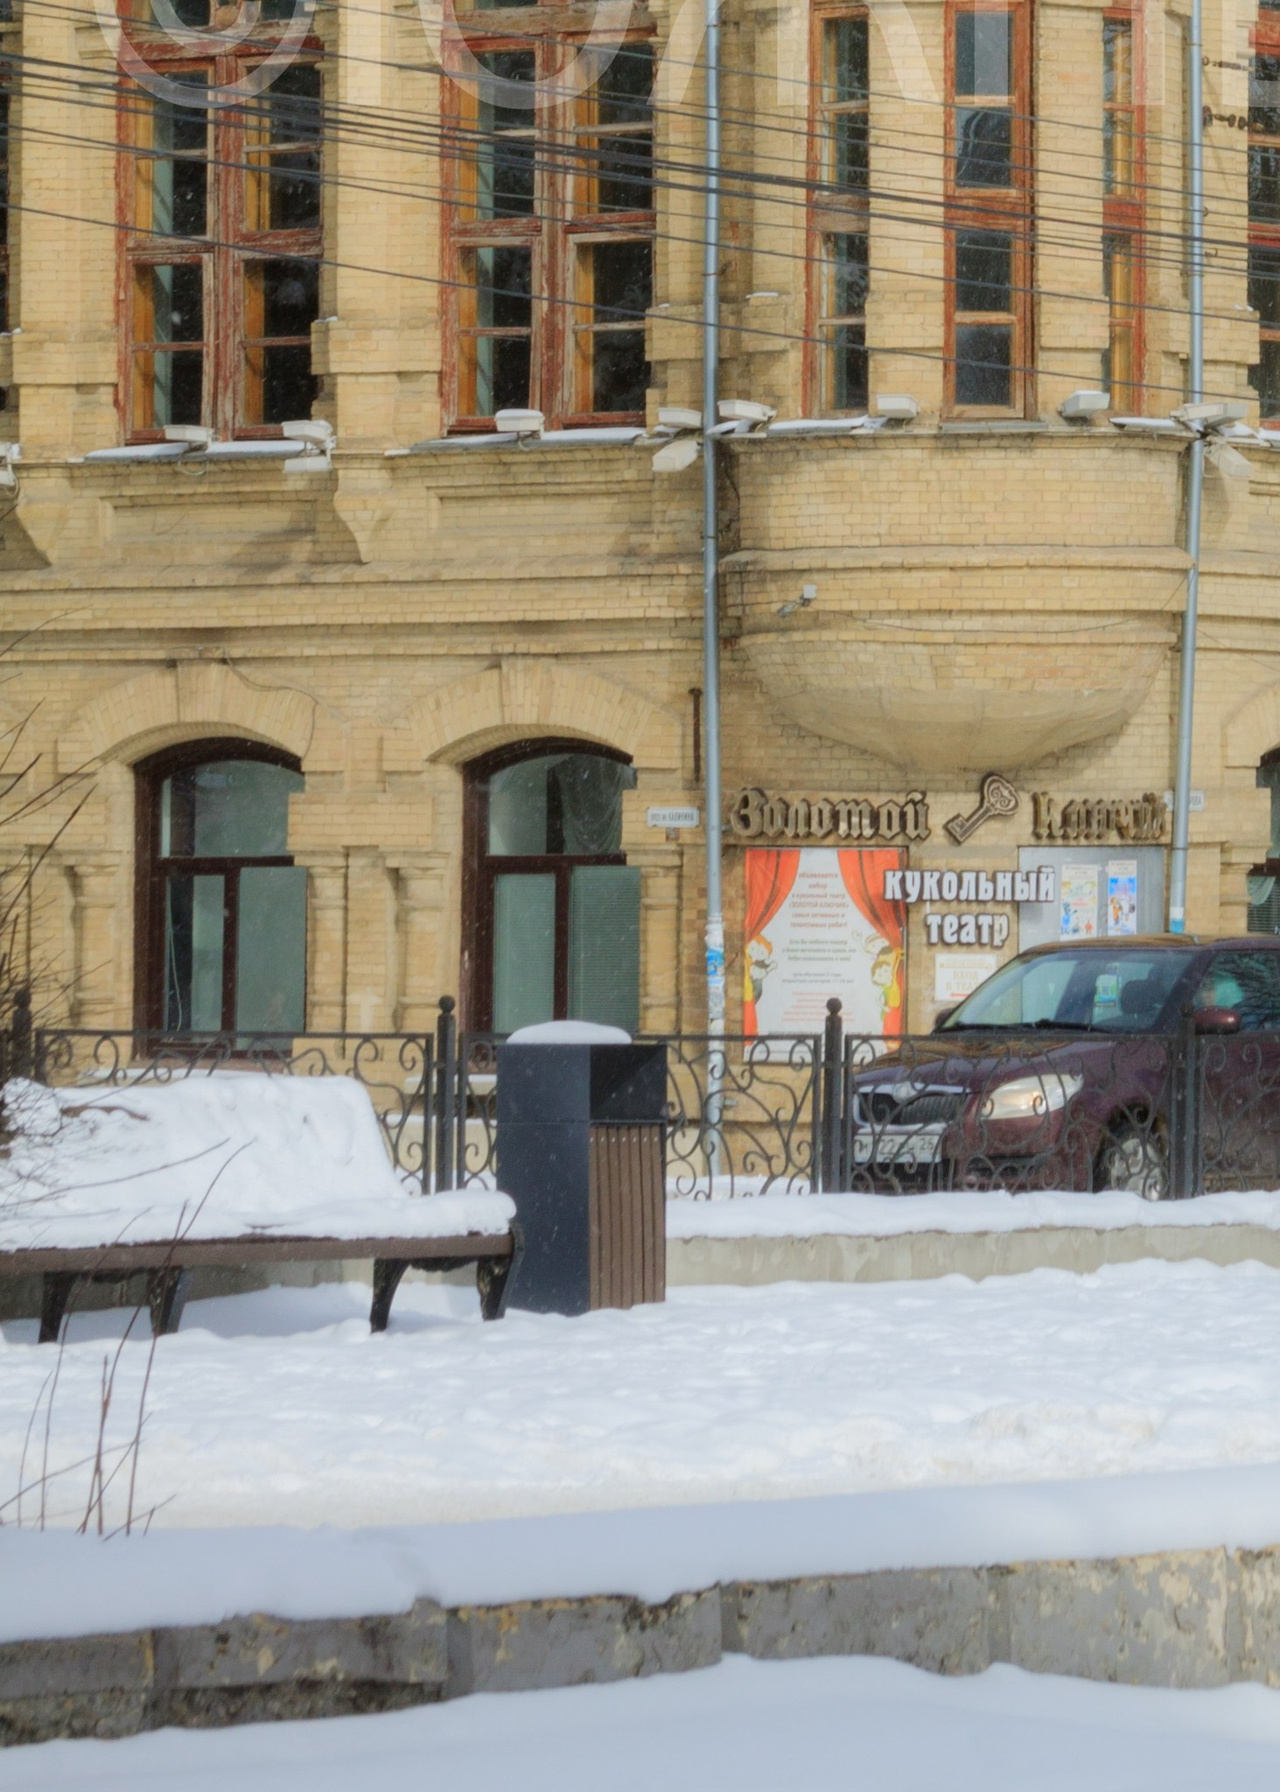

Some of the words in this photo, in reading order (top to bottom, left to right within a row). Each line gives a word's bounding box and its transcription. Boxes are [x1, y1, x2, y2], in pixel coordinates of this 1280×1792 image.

[730, 787, 931, 840] Золотой
[884, 864, 1056, 905] кукольный
[926, 911, 1010, 948] театр
